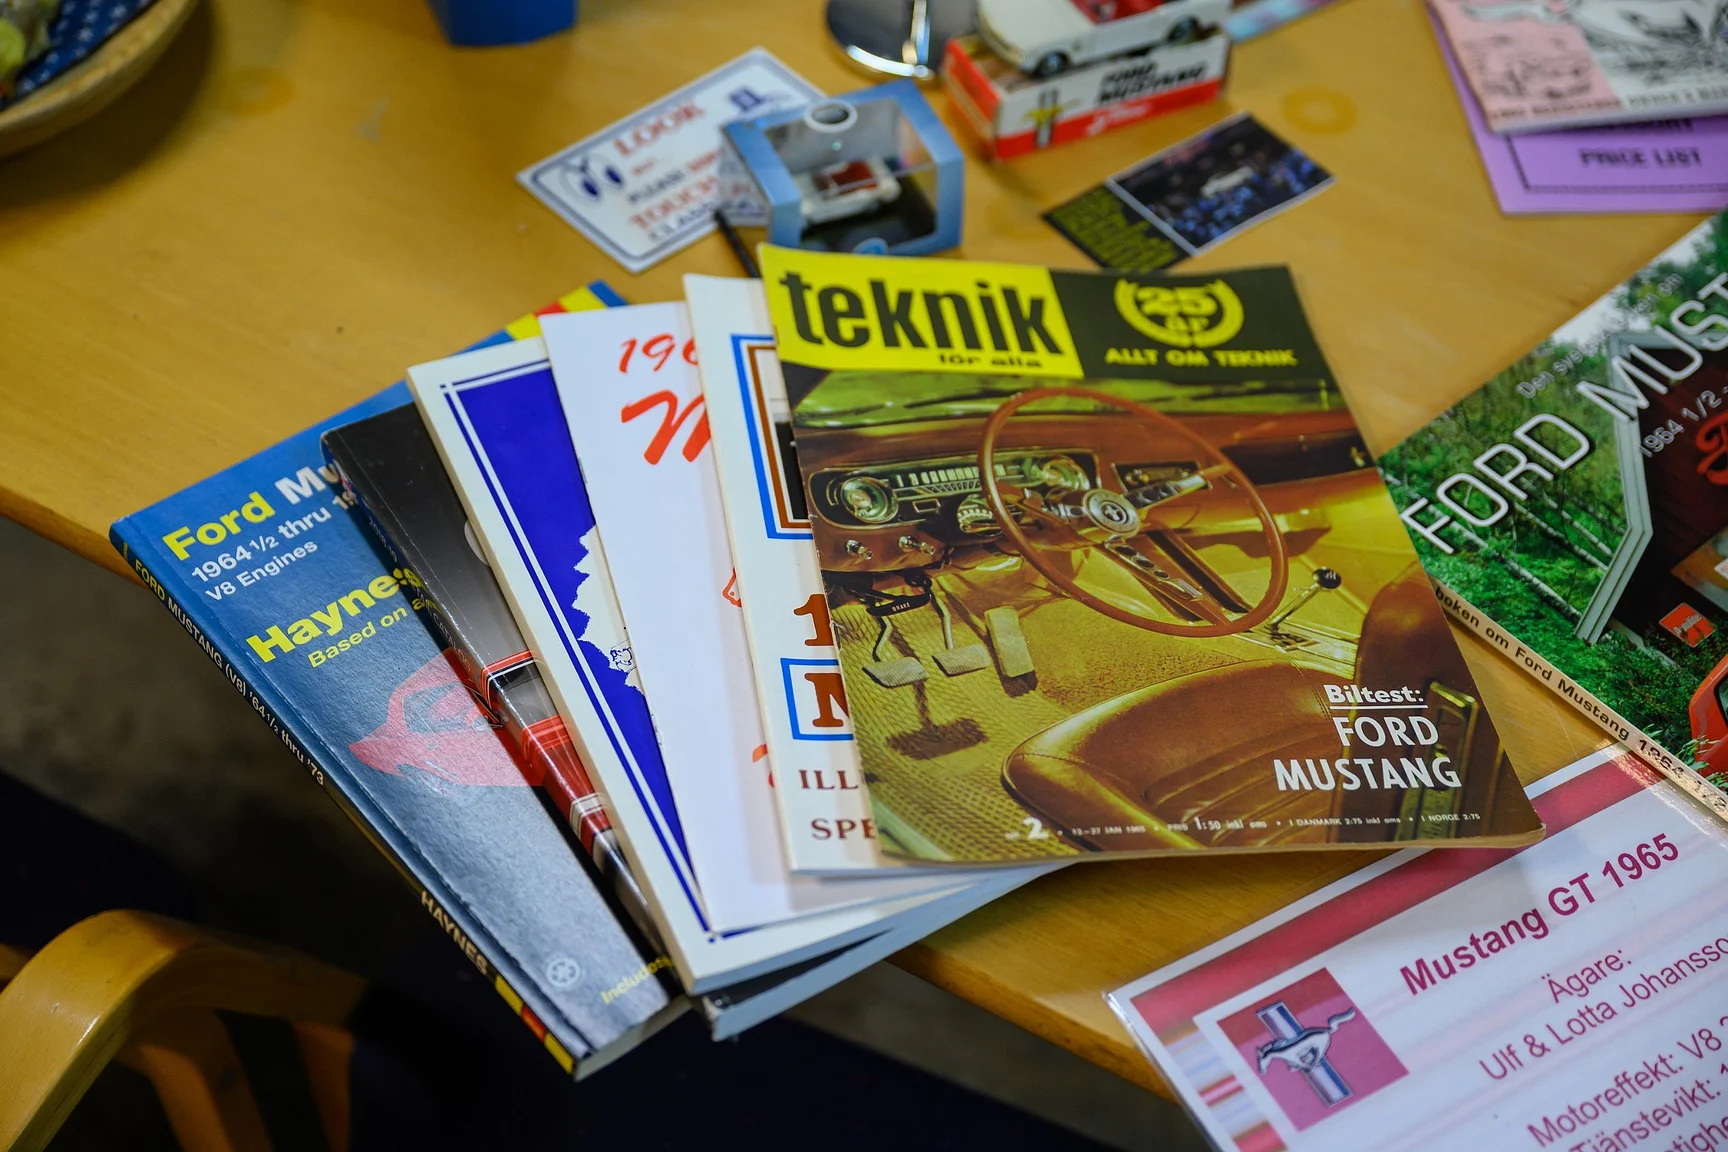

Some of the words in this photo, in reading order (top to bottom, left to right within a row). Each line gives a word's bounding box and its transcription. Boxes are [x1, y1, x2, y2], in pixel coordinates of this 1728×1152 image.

[779, 270, 1065, 354] teknik
[990, 354, 1043, 368] alla
[1105, 348, 1158, 366] ALLT
[1165, 349, 1209, 367] OM
[1212, 349, 1298, 367] TEKNIK
[1639, 419, 1684, 458] 1964
[1400, 413, 1591, 554] FORD
[162, 491, 276, 561] Ford
[277, 507, 332, 541] thru
[205, 581, 238, 601] V8
[236, 541, 319, 588] Engines
[135, 559, 165, 601] FORD
[168, 597, 223, 670] MUSTANG
[225, 663, 247, 697] (V8)
[281, 729, 304, 762] thru
[307, 621, 376, 669] Based
[381, 606, 408, 629] on
[1434, 585, 1480, 628] boken
[1485, 626, 1510, 650] om
[1514, 646, 1553, 681] Ford
[1557, 679, 1630, 741] Mustang
[1323, 684, 1424, 706] Biltest:
[1332, 716, 1439, 747] FORD
[798, 769, 864, 790] ILL
[1273, 757, 1462, 792] MUSTANG
[1023, 816, 1049, 840] 2
[1296, 817, 1342, 826] DANMARK
[1344, 817, 1363, 826] 2:75
[1365, 816, 1381, 825] inkl
[1384, 817, 1402, 825] oms
[1428, 813, 1460, 823] NORGE
[1462, 813, 1481, 821] 2:75
[421, 889, 488, 975] HAYNES
[1399, 908, 1550, 997] Mustang
[1547, 872, 1596, 917] GT
[1602, 832, 1679, 889] 1965
[1541, 949, 1632, 1004] Ägare:
[1478, 1044, 1524, 1081] Ulf
[1523, 1033, 1551, 1058] &
[1546, 1000, 1618, 1045] Lotta
[1527, 1054, 1684, 1148] Motoreffekt:
[1677, 1028, 1722, 1059] V8
[1568, 1080, 1721, 1152] änstevikt:
